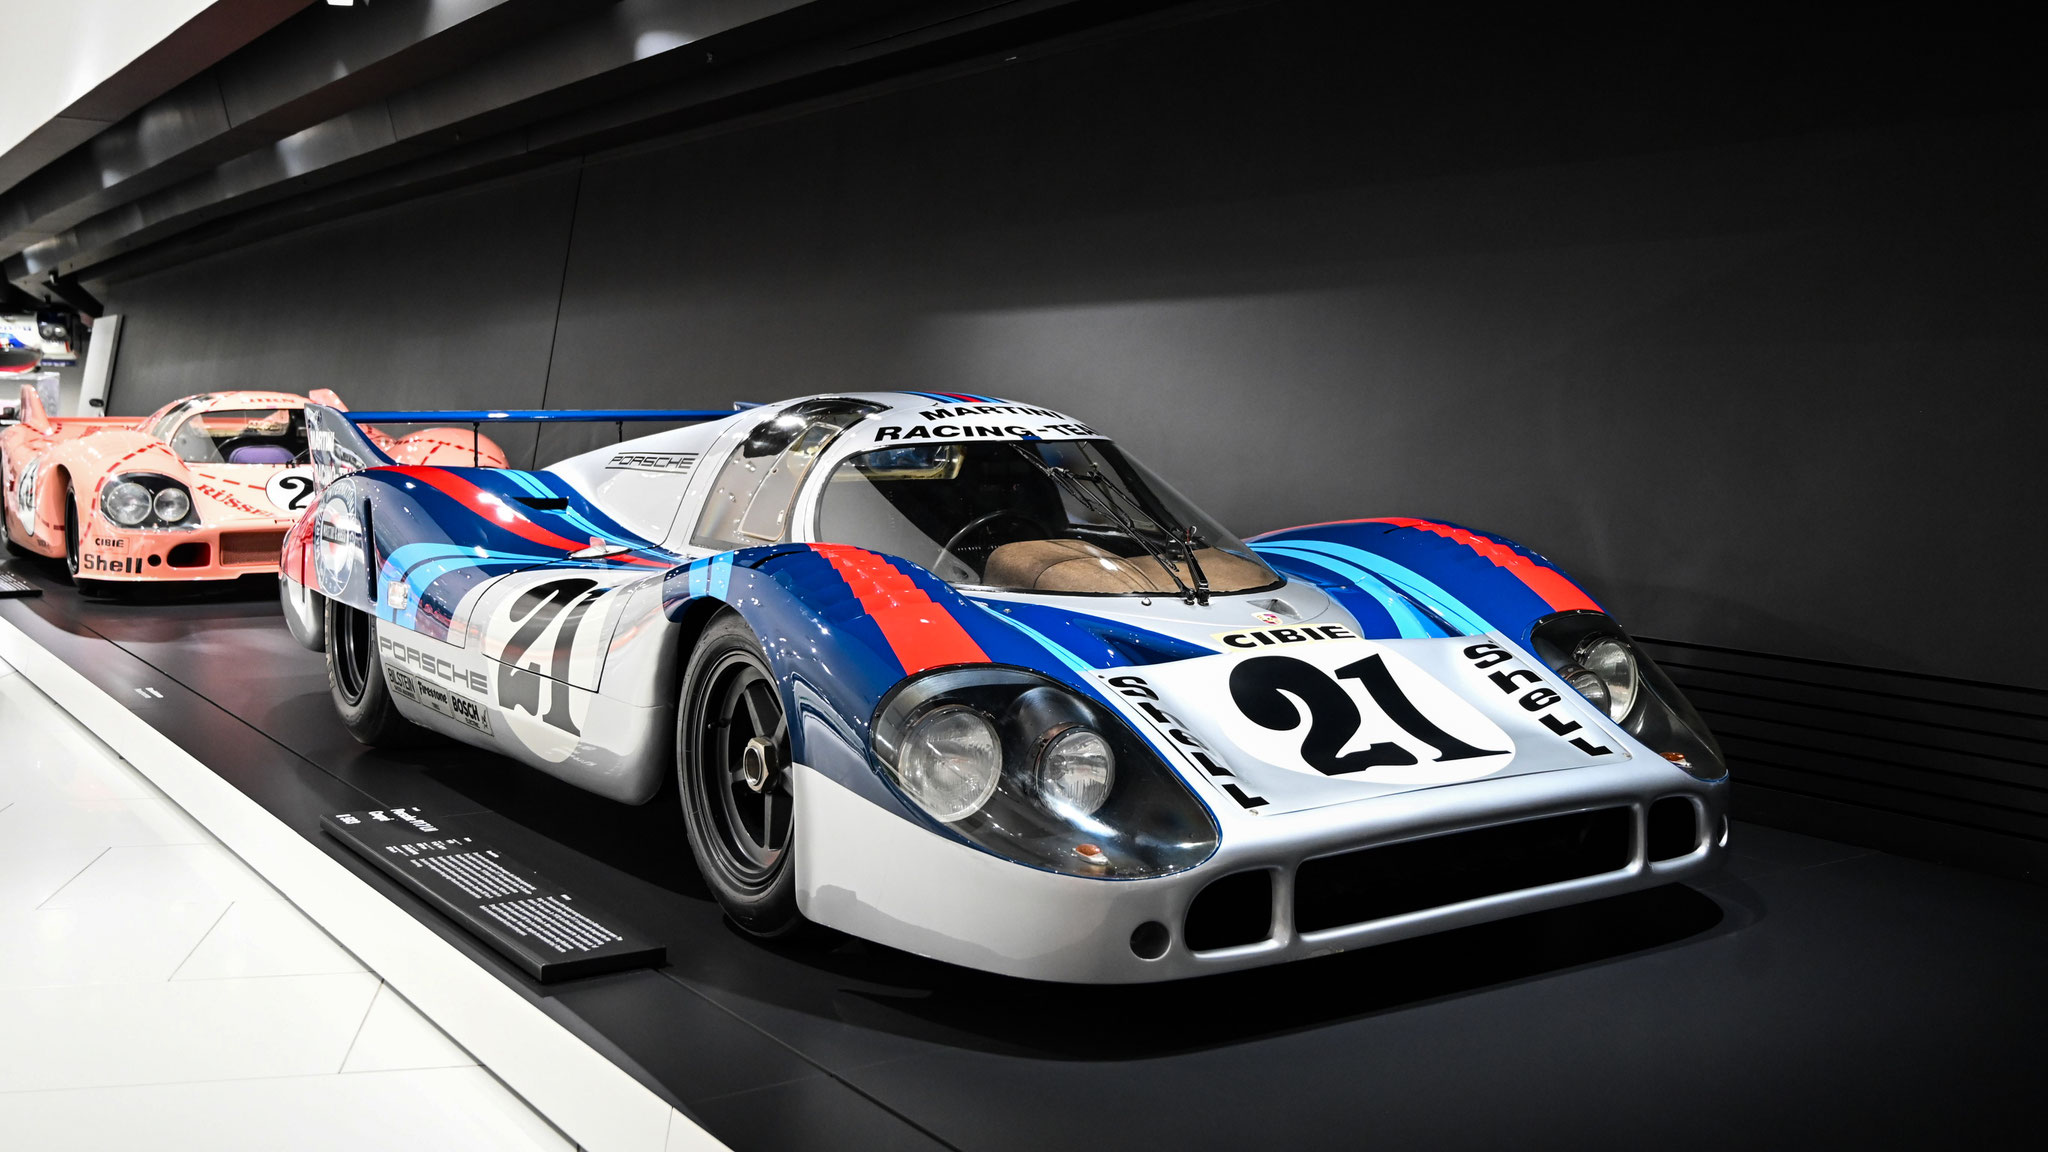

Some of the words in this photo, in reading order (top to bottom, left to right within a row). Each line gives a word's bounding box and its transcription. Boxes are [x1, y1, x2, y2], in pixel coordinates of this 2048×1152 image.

[919, 405, 1066, 421] MARTINI
[608, 455, 696, 469] PORSCHE
[94, 537, 124, 548] CIBIE
[84, 553, 143, 574] Shell
[1222, 625, 1357, 648] CIBIE
[379, 635, 489, 696] PORSCHE
[498, 578, 599, 738] 21
[387, 667, 416, 693] BILSTEIN
[417, 680, 448, 705] Firestone
[451, 695, 480, 722] BOSCH
[1229, 653, 1512, 776] 21
